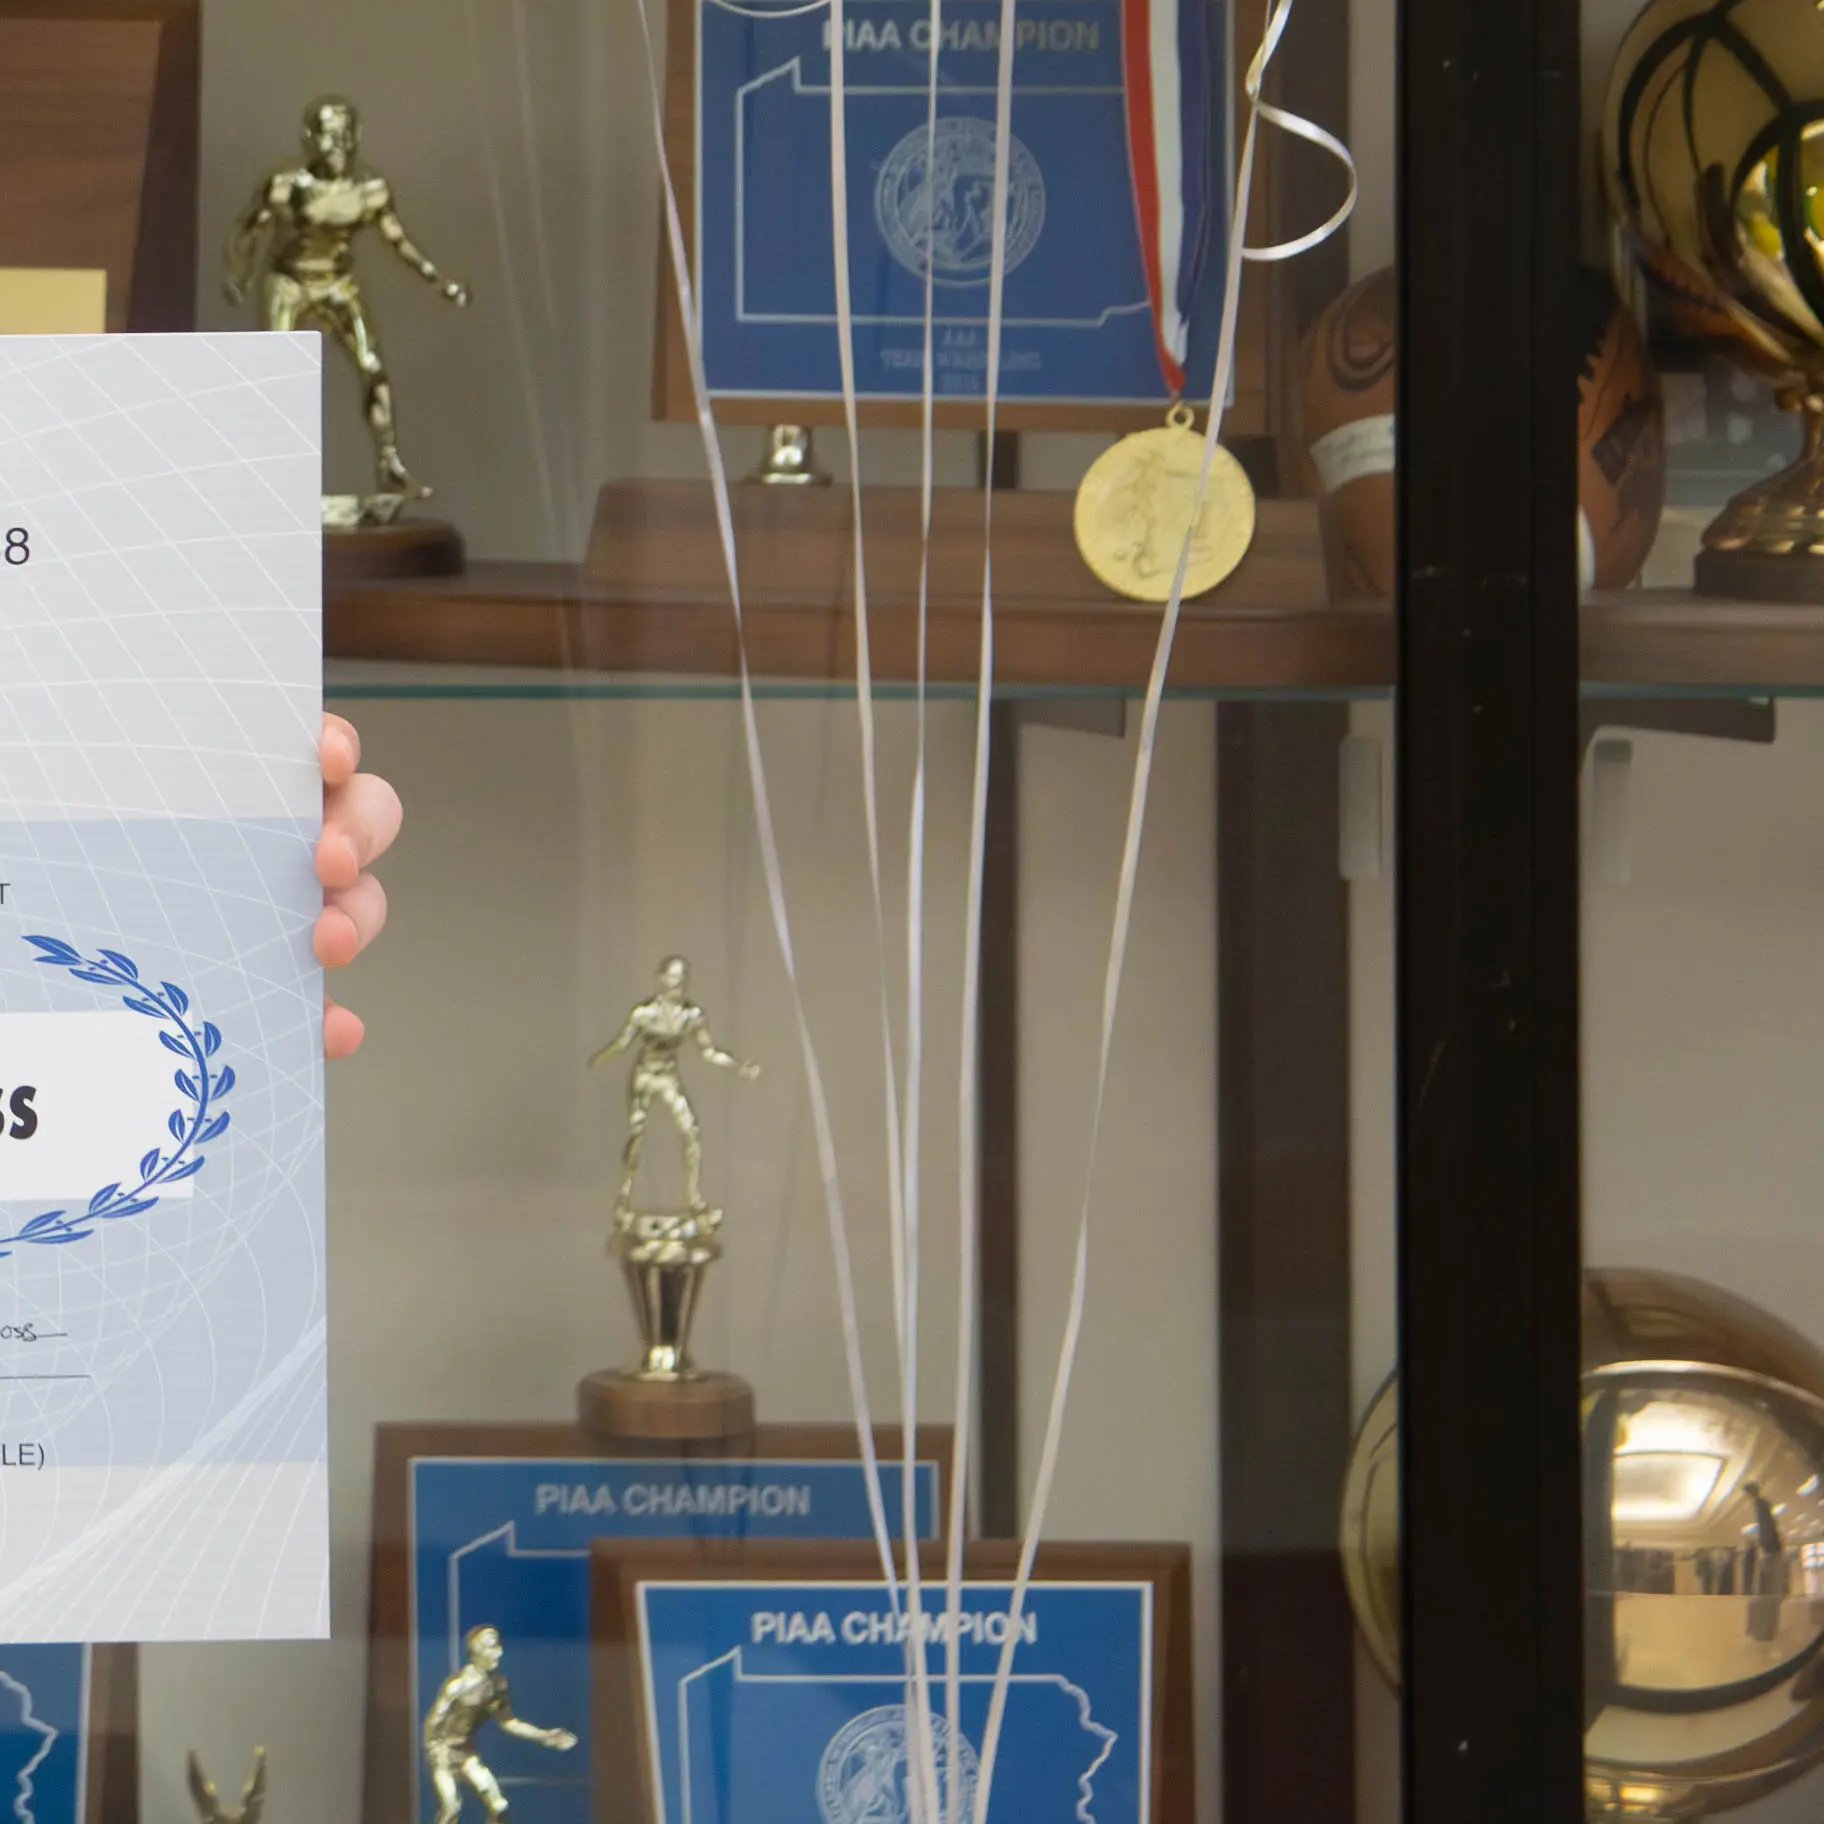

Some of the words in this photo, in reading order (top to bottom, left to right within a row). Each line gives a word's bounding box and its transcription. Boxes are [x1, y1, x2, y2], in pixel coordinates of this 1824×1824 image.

[909, 20, 1100, 52] CHAMPION
[535, 1483, 617, 1515] PIAA
[622, 1483, 812, 1516] CHAMPION
[751, 1610, 836, 1645] PIAA
